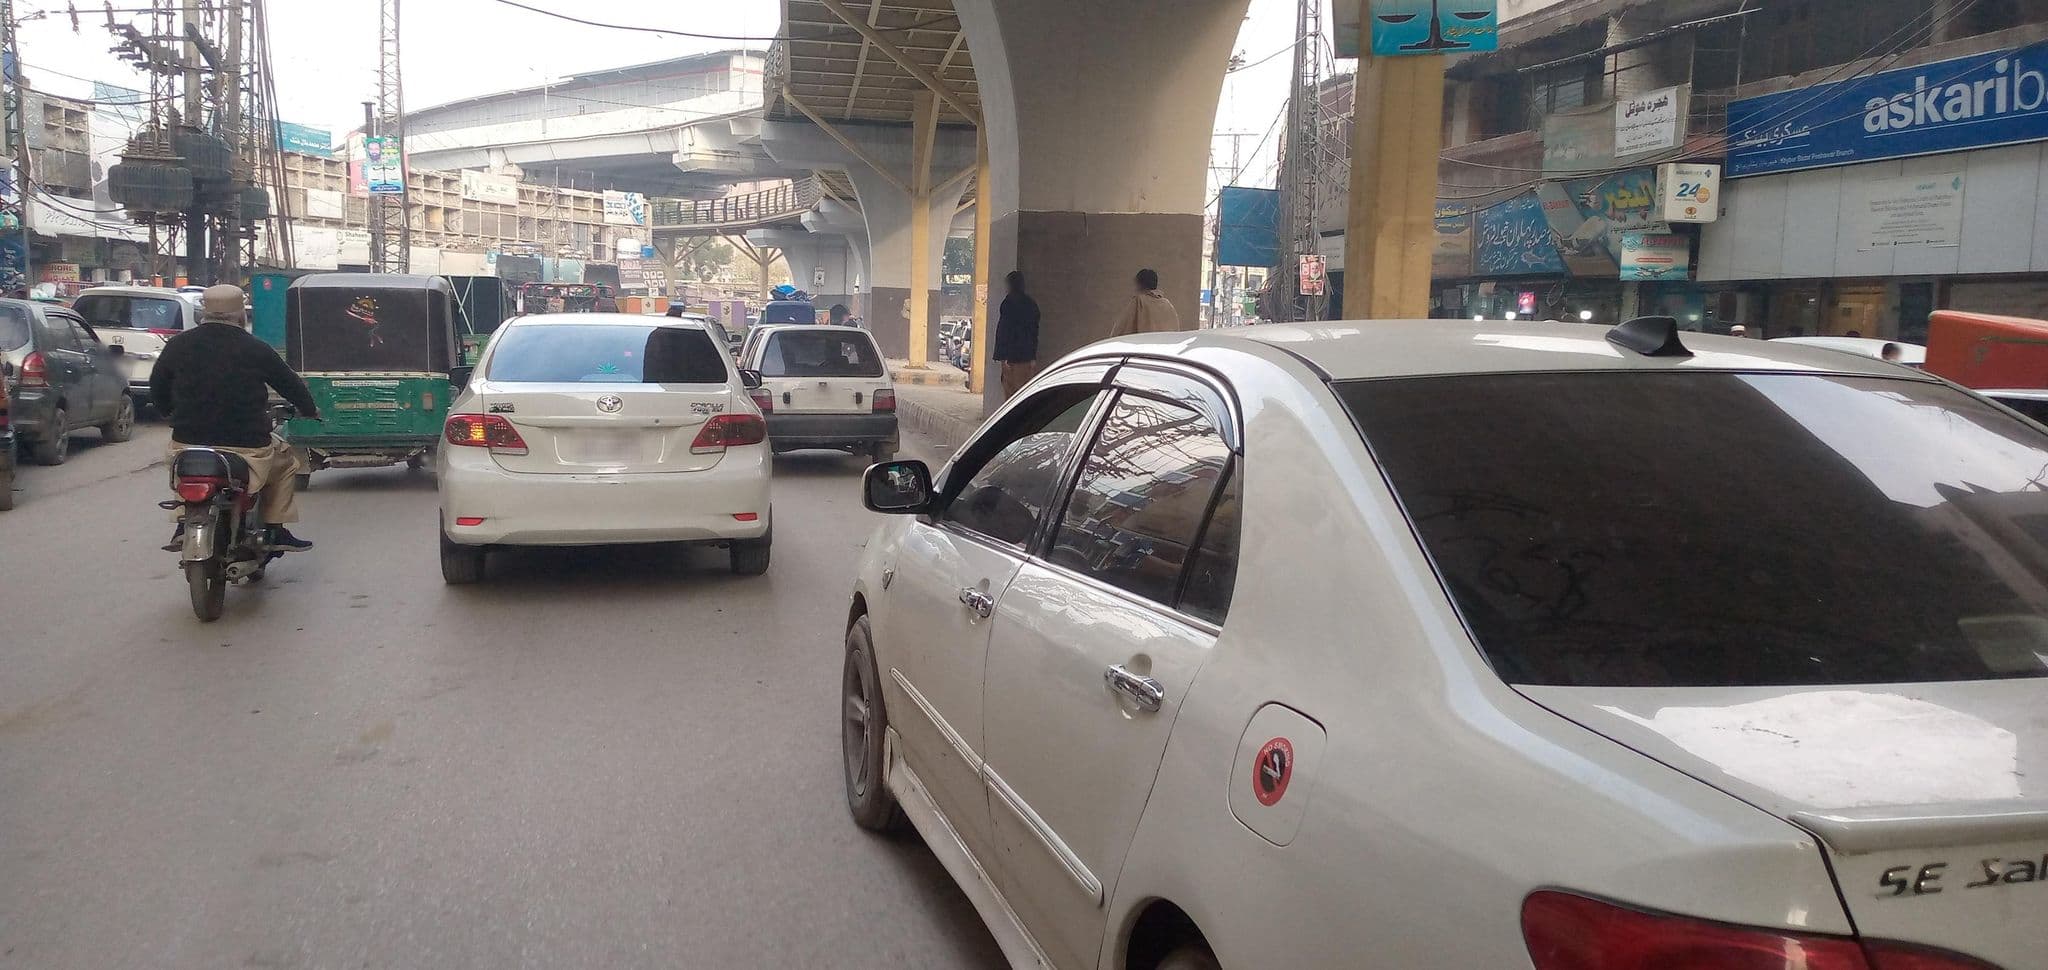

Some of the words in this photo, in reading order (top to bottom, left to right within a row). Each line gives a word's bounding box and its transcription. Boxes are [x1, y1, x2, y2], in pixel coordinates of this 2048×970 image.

[1863, 58, 2048, 134] askarib
[1836, 148, 1855, 157] Branch
[1676, 182, 1701, 198] 24
[1879, 862, 1949, 897] SE
